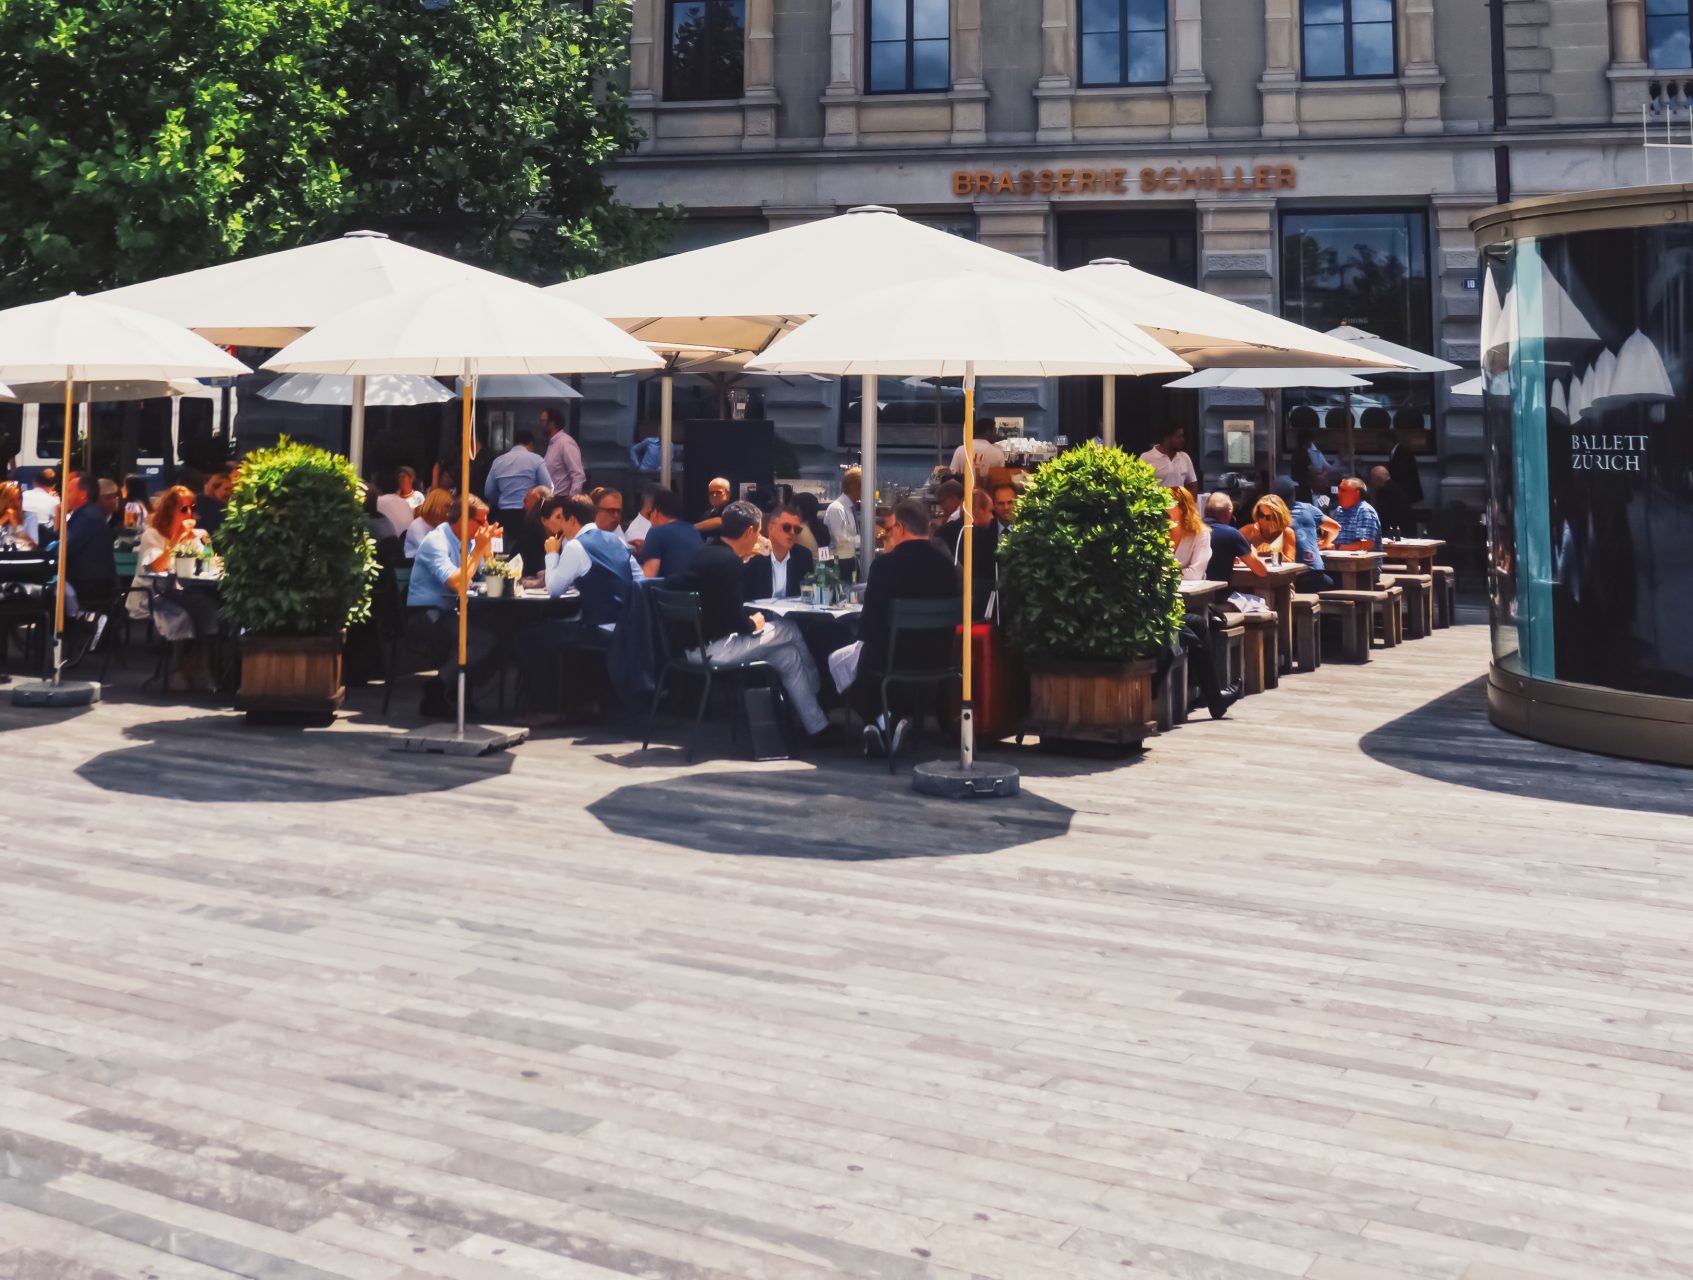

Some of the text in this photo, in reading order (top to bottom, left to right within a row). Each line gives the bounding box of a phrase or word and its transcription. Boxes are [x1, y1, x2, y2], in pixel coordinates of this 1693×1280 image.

[952, 164, 1297, 196] BRASSERIE SCHILLER
[1466, 279, 1476, 289] 10
[1571, 434, 1649, 451] BALLETT
[1571, 450, 1641, 471] ZÜRICH
